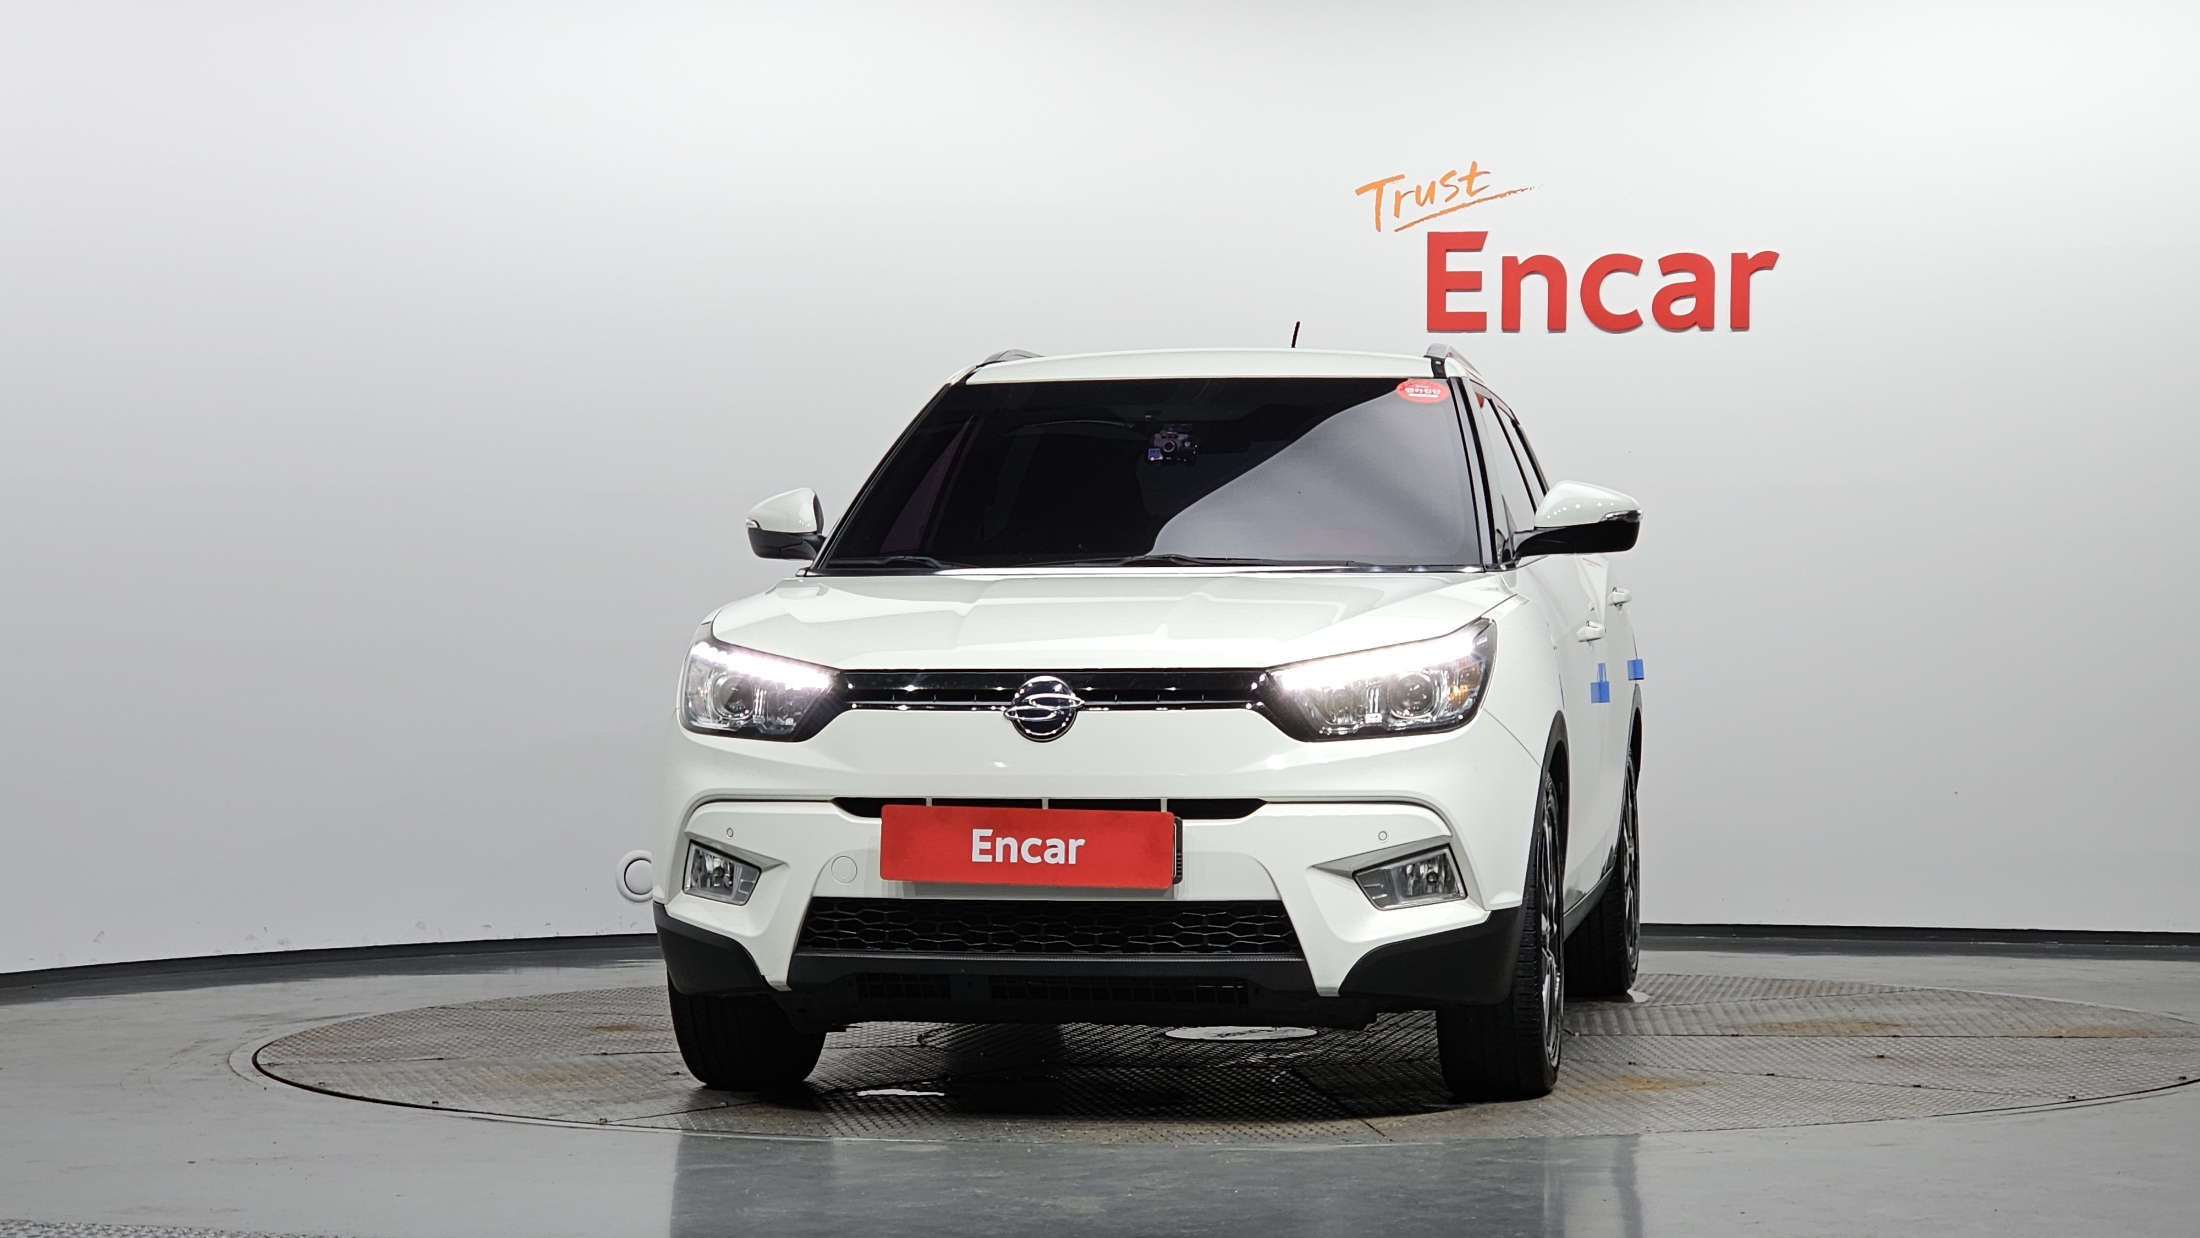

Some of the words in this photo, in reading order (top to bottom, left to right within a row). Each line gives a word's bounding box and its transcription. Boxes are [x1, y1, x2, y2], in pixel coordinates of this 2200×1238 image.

[1355, 161, 1491, 232] Trust
[1426, 231, 1780, 333] Encar
[971, 828, 1086, 865] Encar
